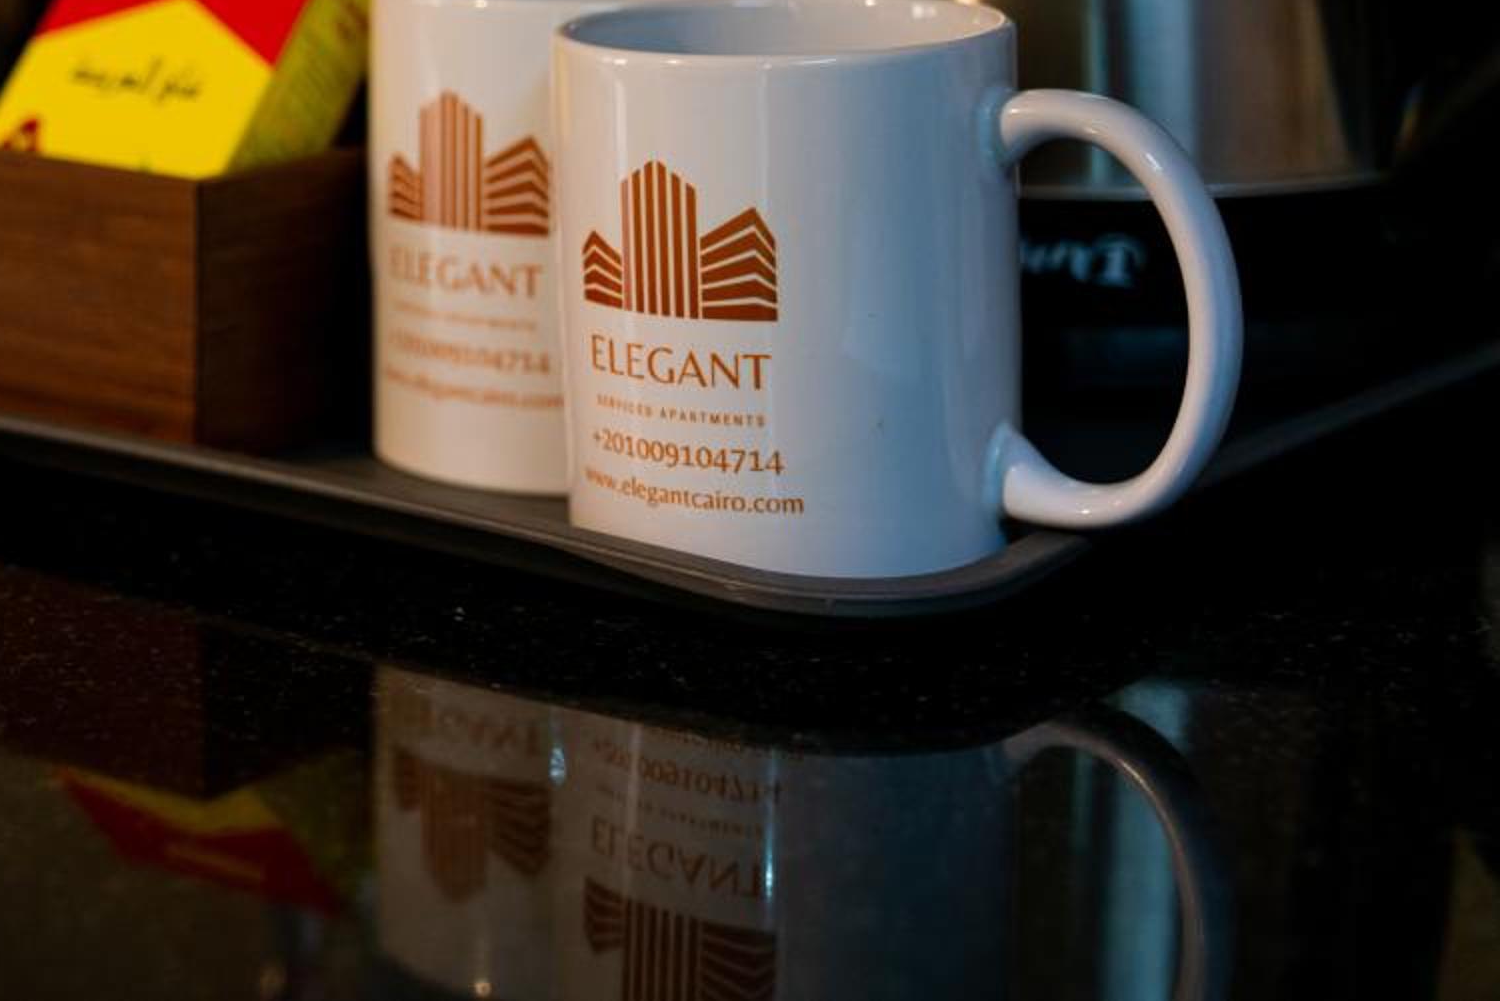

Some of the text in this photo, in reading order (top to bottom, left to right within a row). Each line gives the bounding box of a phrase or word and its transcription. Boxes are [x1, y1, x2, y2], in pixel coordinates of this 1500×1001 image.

[387, 245, 543, 299] ELEGANT
[591, 333, 773, 391] ELEGANT
[659, 405, 767, 428] APARTMENTS
[592, 427, 786, 476] +201009104714
[584, 464, 806, 516] www.elegantcairo.com
